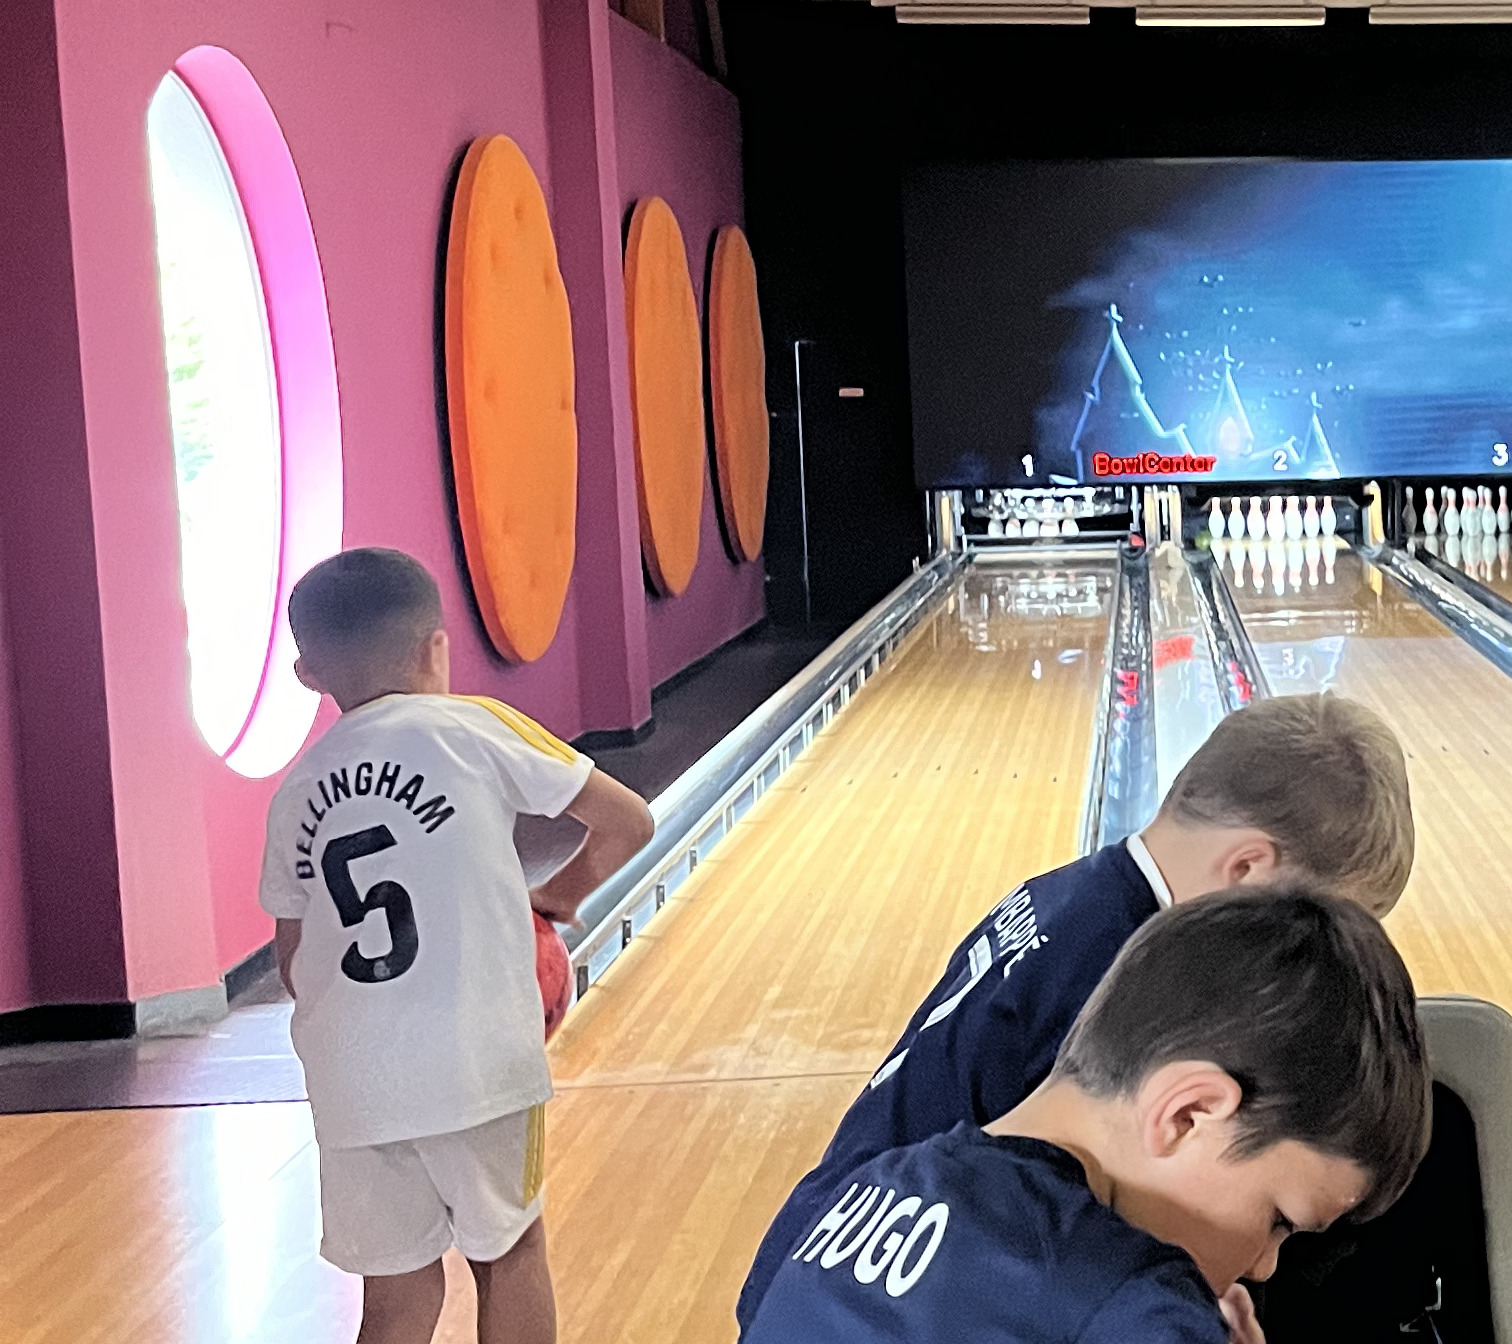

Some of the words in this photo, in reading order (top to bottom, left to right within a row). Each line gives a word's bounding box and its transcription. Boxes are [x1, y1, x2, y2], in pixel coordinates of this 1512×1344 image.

[1021, 454, 1034, 477] 1
[1273, 450, 1289, 471] 2
[1491, 442, 1509, 466] 3
[321, 824, 419, 983] 5
[791, 1181, 950, 1297] HUGO
